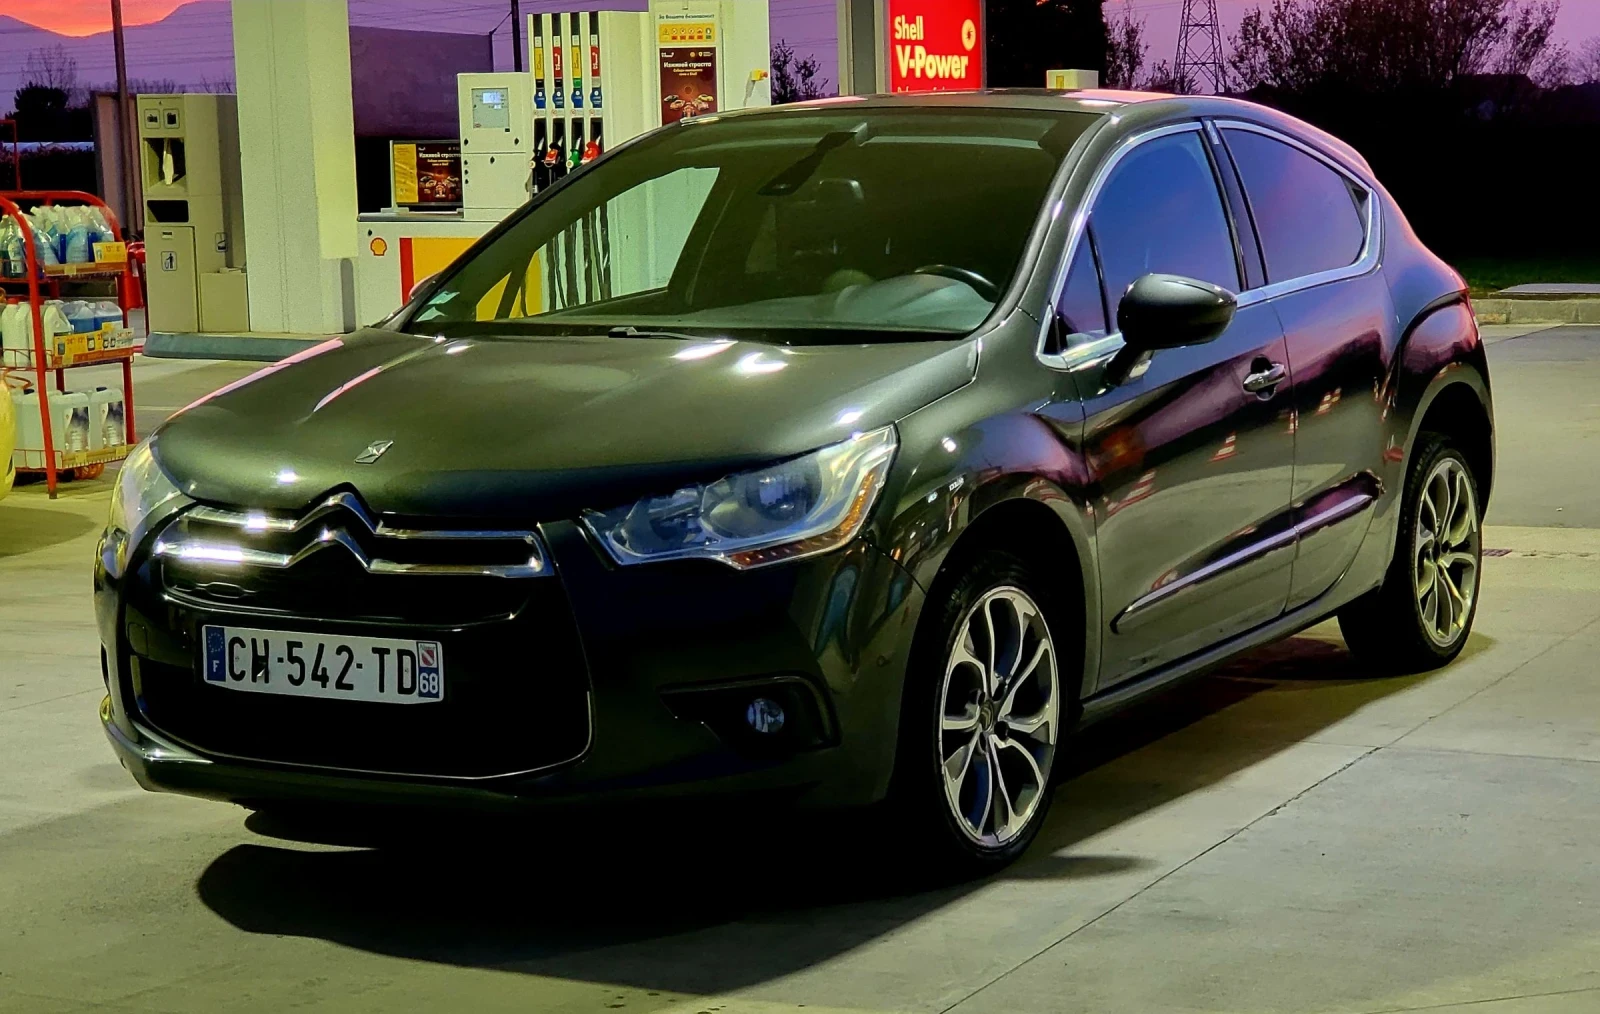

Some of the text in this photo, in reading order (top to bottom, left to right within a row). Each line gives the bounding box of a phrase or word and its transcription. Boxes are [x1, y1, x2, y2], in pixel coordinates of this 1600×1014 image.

[894, 14, 924, 41] Shell
[895, 44, 969, 79] V-Power
[212, 660, 220, 673] F
[227, 635, 417, 696] CH-542-TD
[419, 672, 439, 694] 68
